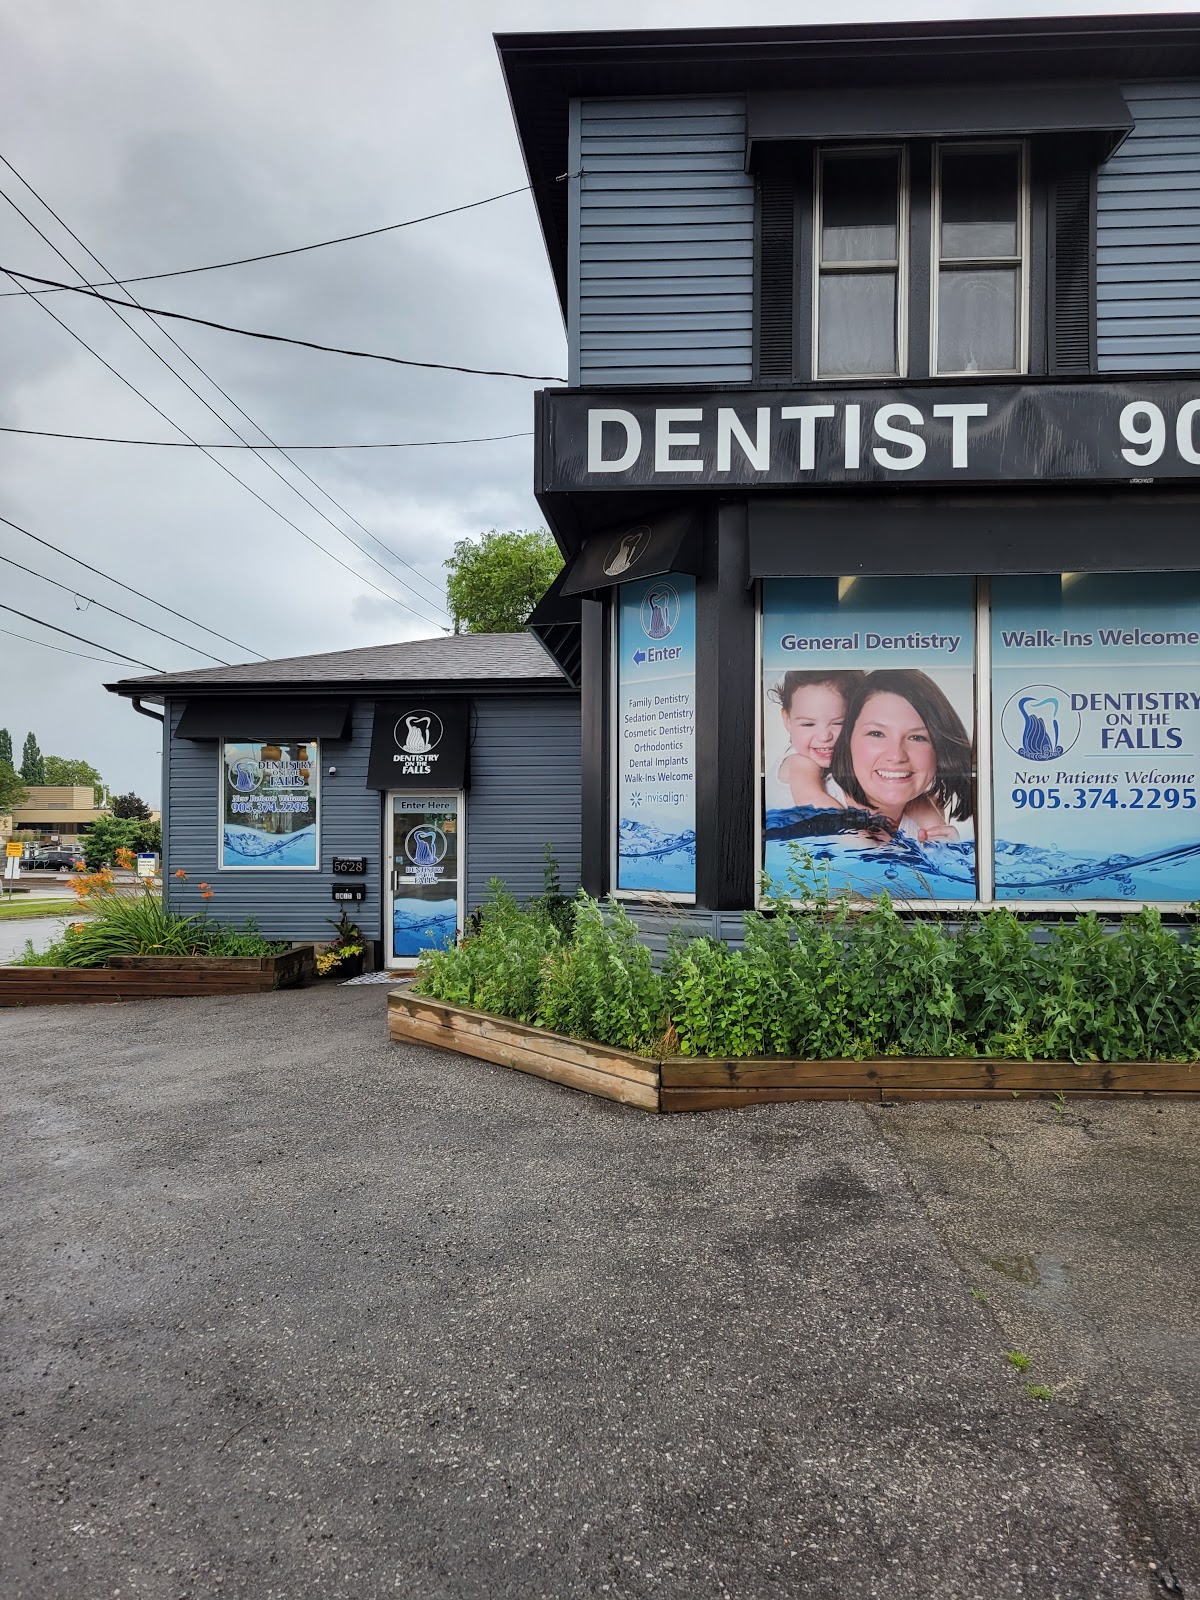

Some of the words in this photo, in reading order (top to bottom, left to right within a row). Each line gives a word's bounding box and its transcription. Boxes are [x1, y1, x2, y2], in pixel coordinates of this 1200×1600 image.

[587, 403, 988, 473] DENTIST
[780, 633, 859, 651] General
[865, 632, 961, 653] Dentistry
[1001, 630, 1093, 648] Walk-Ins
[1098, 628, 1200, 646] Welcome
[647, 646, 682, 663] Enter
[629, 697, 653, 708] Family
[654, 693, 690, 705] Dentistry
[1070, 692, 1200, 711] DENTISTRY
[624, 712, 656, 724] Sedation
[658, 708, 694, 720] Dentistry
[1105, 713, 1133, 726] ON
[1138, 712, 1170, 725] THE
[624, 727, 657, 738] Cosmetic
[659, 724, 694, 736] Dentistry
[1101, 727, 1183, 749] FALLS
[634, 740, 683, 753] Orthodontics
[258, 761, 313, 769] DENTISTRY
[393, 754, 440, 762] DENTISTRY
[629, 757, 653, 768] Dental
[655, 756, 689, 768] Implants
[402, 766, 431, 774] FALLS
[1013, 771, 1050, 785] New
[1055, 771, 1119, 784] Patients
[1124, 768, 1195, 784] Welcome
[270, 776, 305, 786] FALLS
[624, 773, 656, 783] Walk-Ins
[657, 772, 694, 782] Welcome
[401, 802, 426, 810] Enter
[428, 801, 450, 809] Here
[1011, 788, 1197, 810] 905.374.2295
[231, 801, 309, 813] 905.374.2295
[334, 861, 363, 872] 5628
